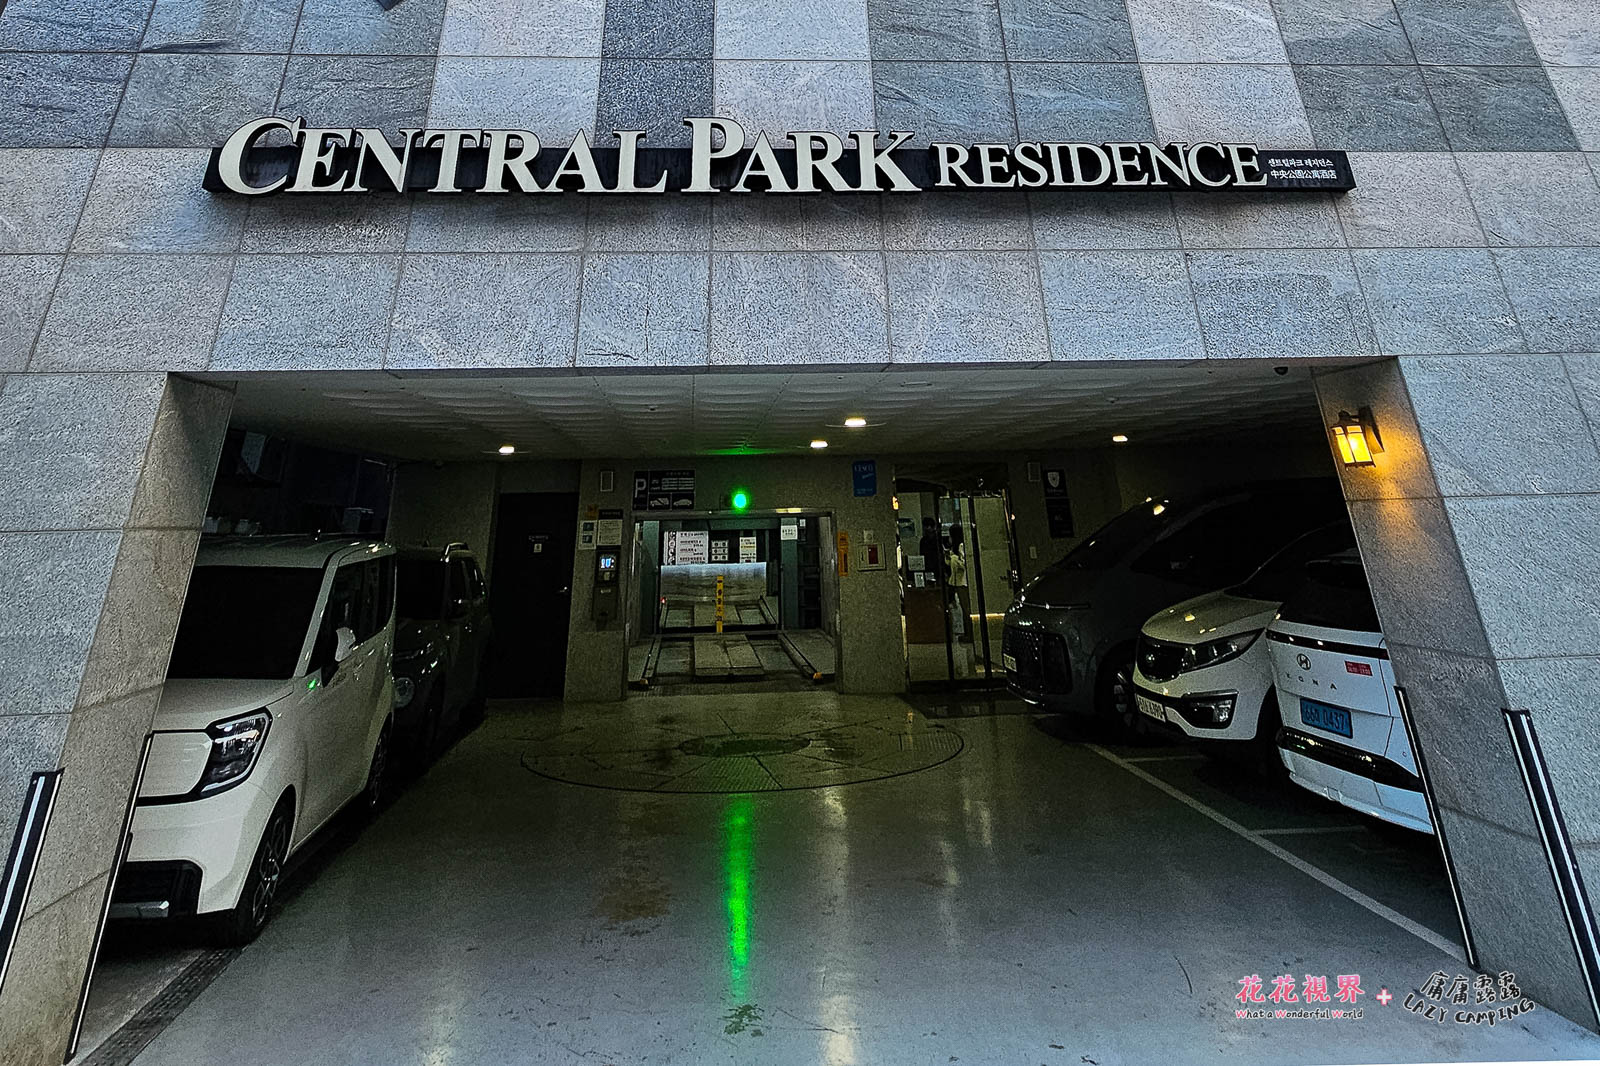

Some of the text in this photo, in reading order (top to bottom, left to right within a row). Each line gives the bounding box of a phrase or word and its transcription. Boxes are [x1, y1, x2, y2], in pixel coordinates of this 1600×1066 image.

[218, 116, 1268, 195] CENTRAL PARK RESIDENCE
[634, 478, 647, 499] P
